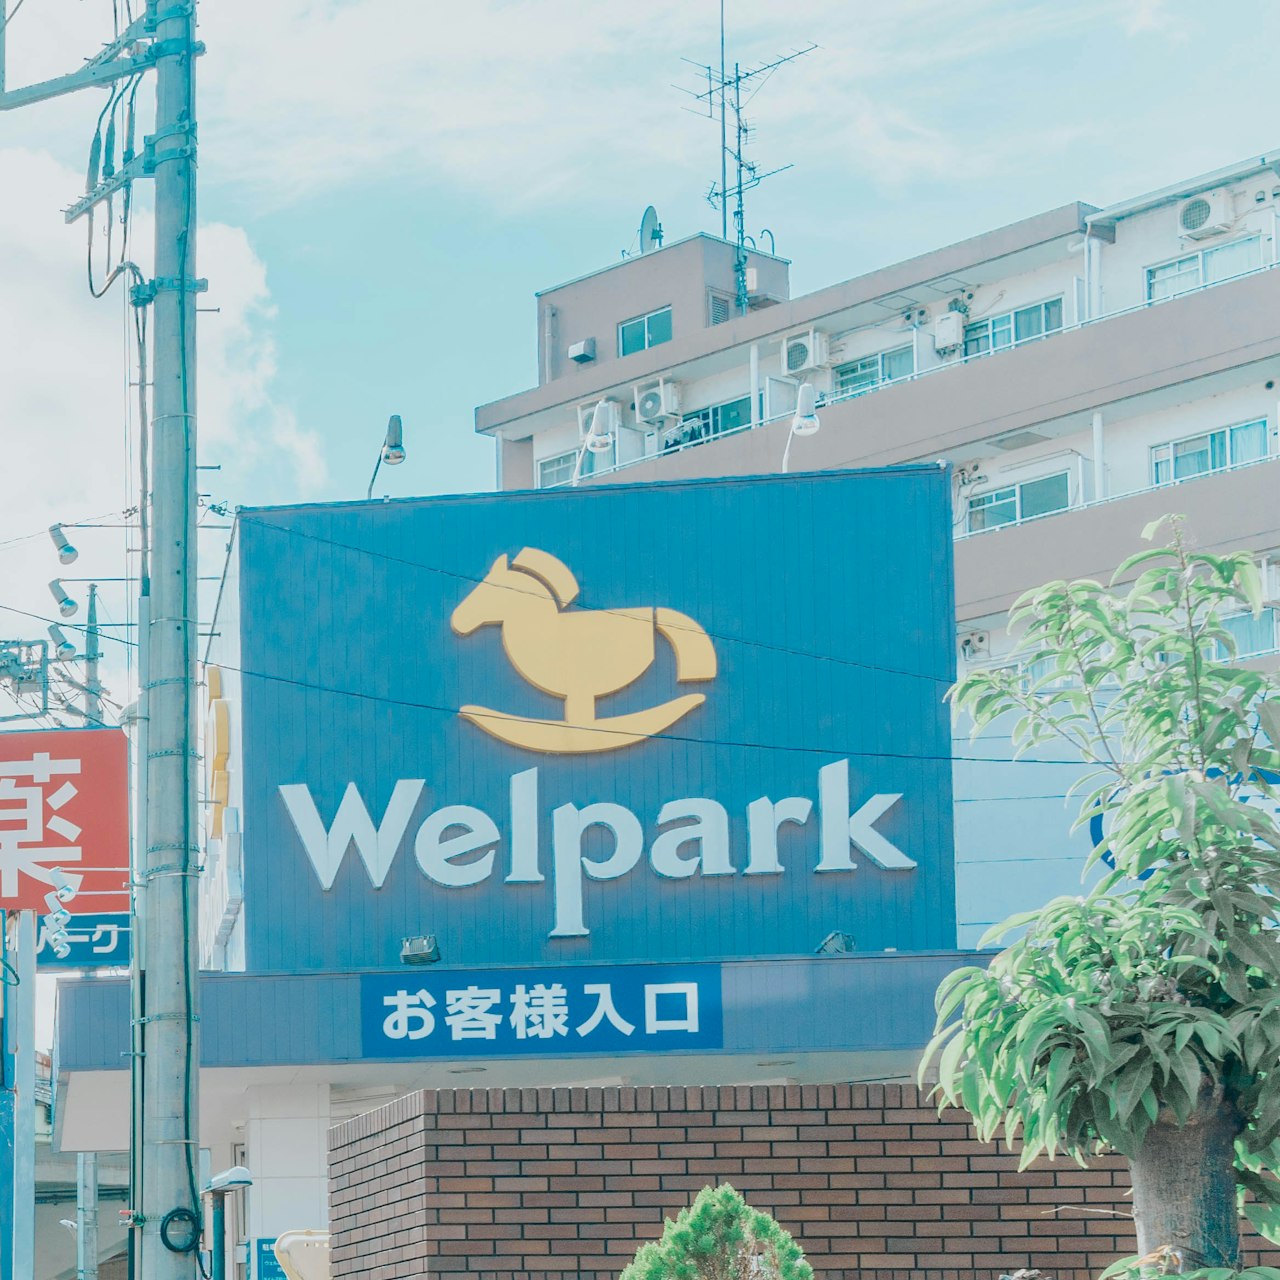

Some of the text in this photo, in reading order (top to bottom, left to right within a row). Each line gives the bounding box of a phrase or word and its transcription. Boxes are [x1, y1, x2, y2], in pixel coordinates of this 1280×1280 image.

[278, 758, 918, 937] Welpark
[382, 981, 701, 1041] お客様入口
